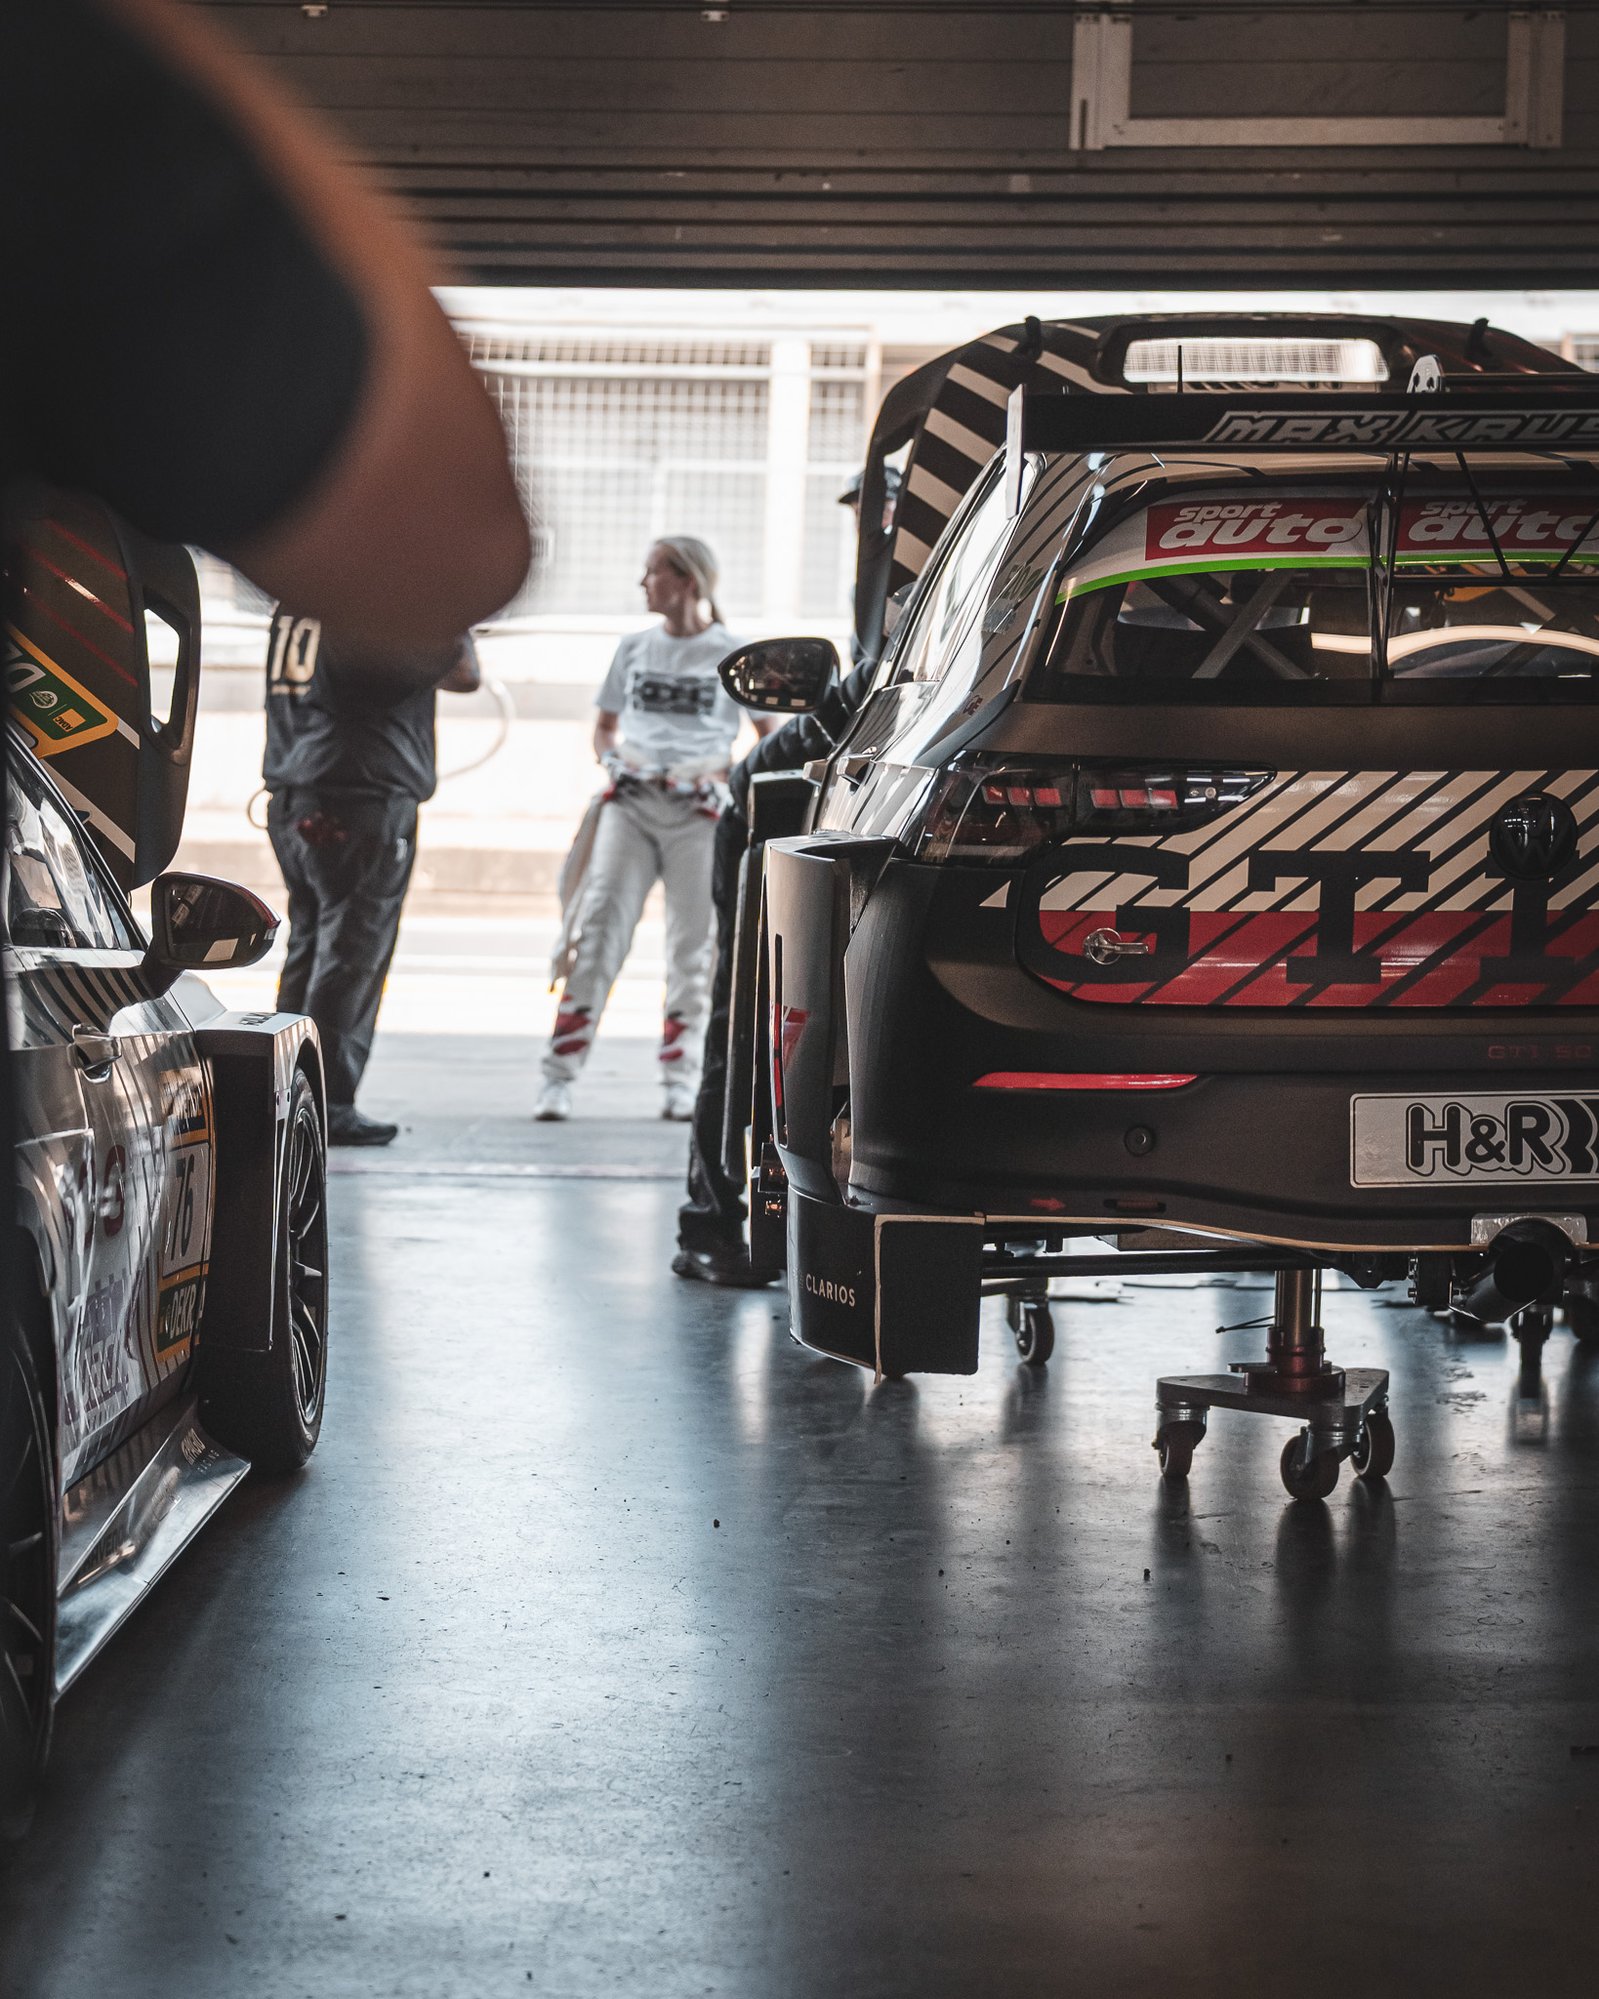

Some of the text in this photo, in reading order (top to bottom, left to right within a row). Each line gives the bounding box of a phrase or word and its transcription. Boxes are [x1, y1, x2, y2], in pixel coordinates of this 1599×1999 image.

[1214, 414, 1391, 443] MAX
[1173, 501, 1283, 521] sport
[1419, 497, 1529, 518] sport
[1158, 512, 1364, 550] auto
[270, 615, 322, 683] 10
[54, 716, 74, 733] ADAC
[1018, 843, 1581, 985] GTI
[1407, 1101, 1560, 1173] H&R
[170, 1154, 195, 1261] 76
[805, 1273, 856, 1307] CLARIOS
